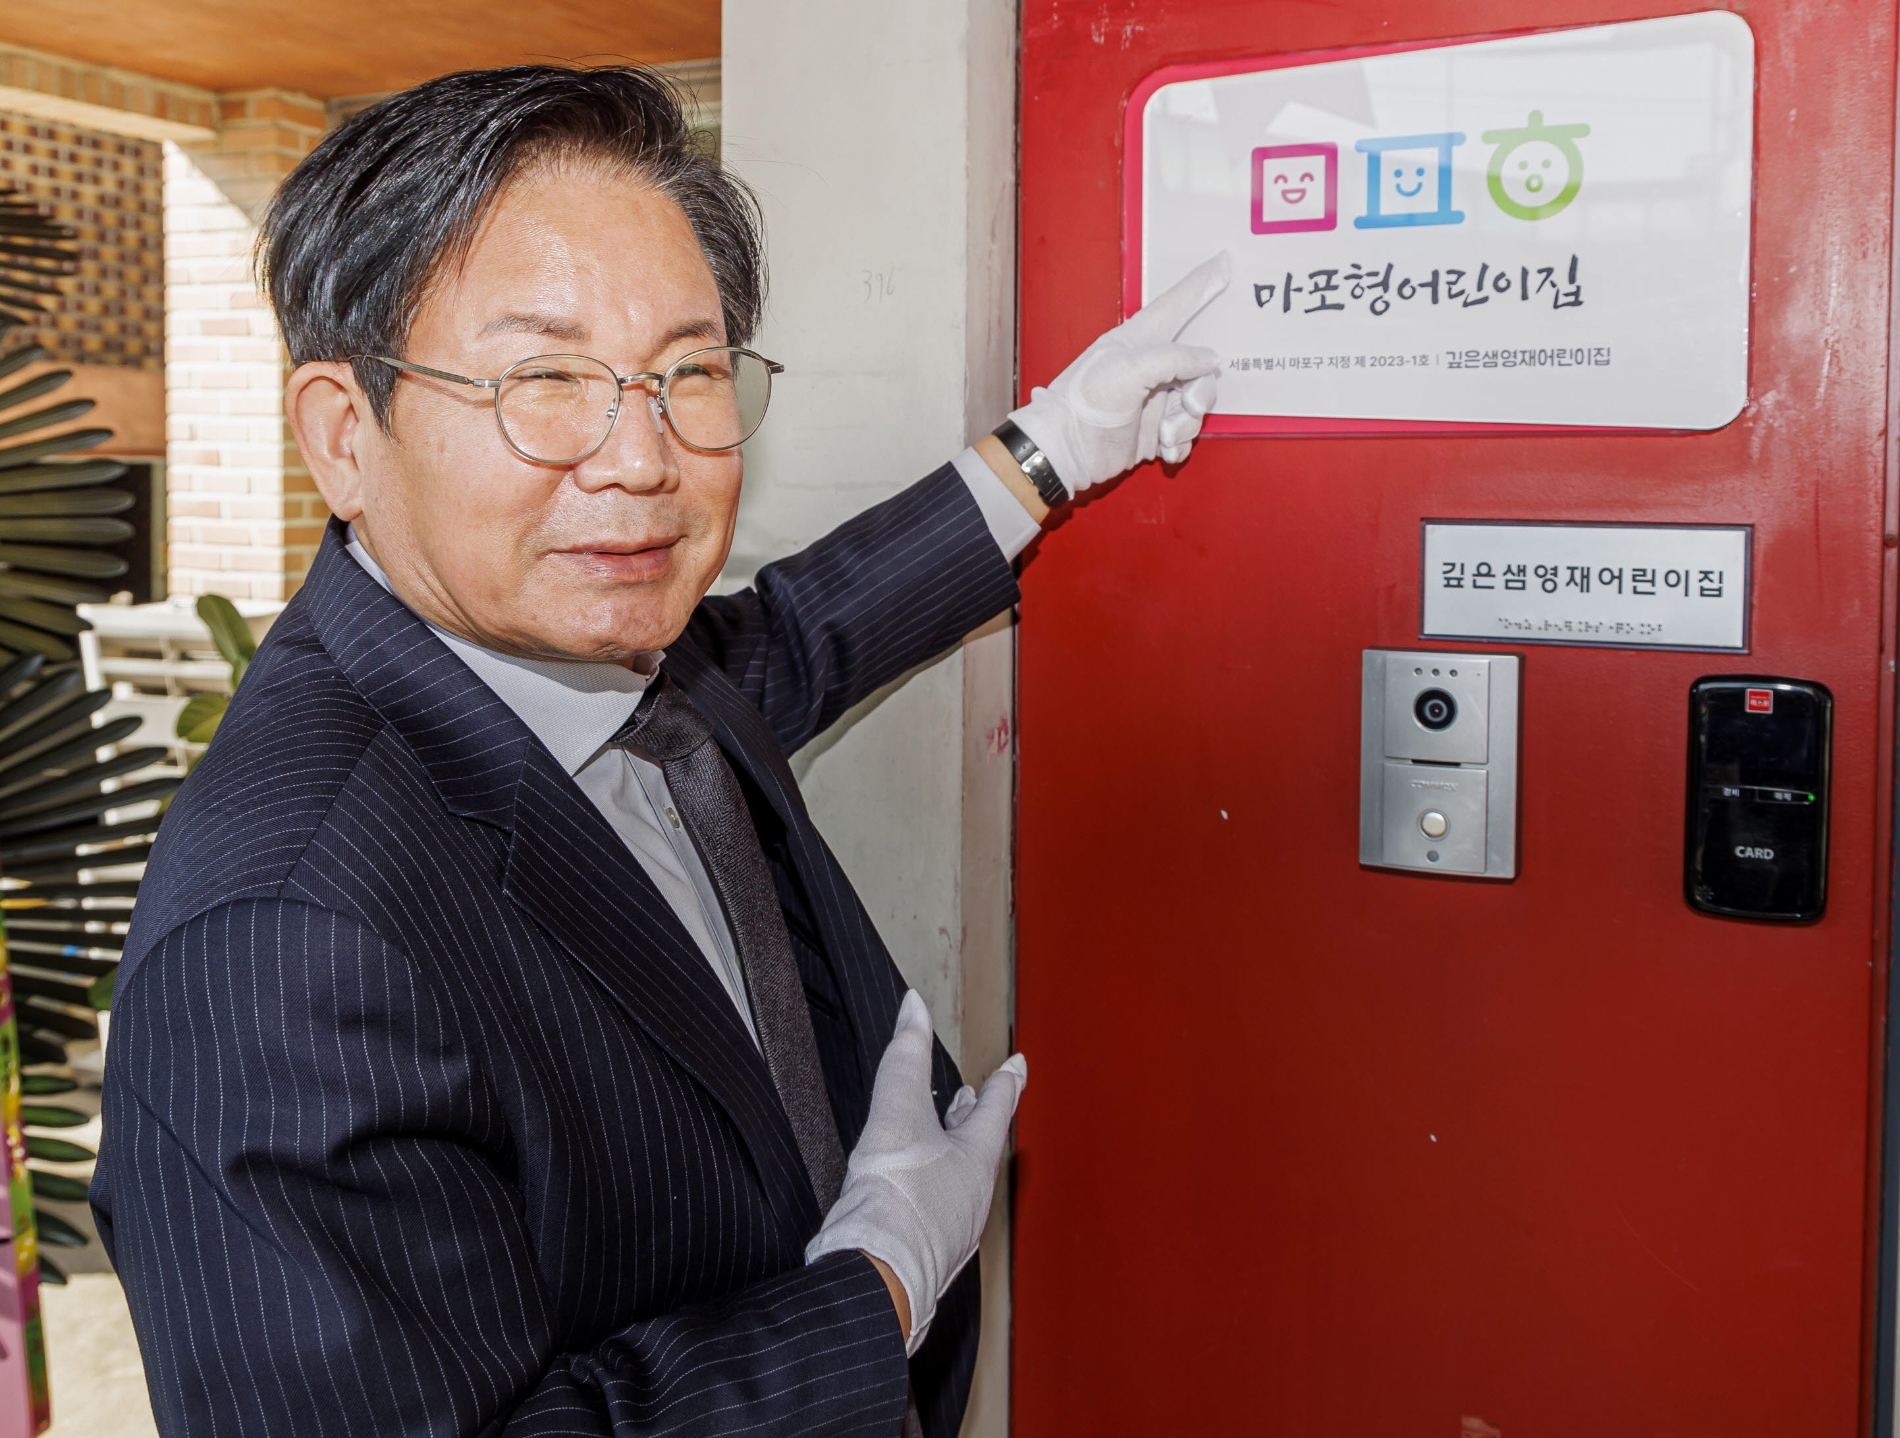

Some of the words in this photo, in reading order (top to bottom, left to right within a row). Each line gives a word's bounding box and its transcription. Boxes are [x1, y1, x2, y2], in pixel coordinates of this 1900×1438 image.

[1253, 254, 1584, 316] 마포형어린이집
[1229, 357, 1286, 371] 서울특별시
[1289, 356, 1324, 370] 마포구
[1327, 355, 1350, 369] 지정
[1369, 354, 1430, 367] 2023-1호
[1446, 347, 1611, 369] 깊은샘영재어린이집
[1442, 562, 1725, 598] 깊은샘영재어린이집
[1734, 846, 1775, 860] CARD
